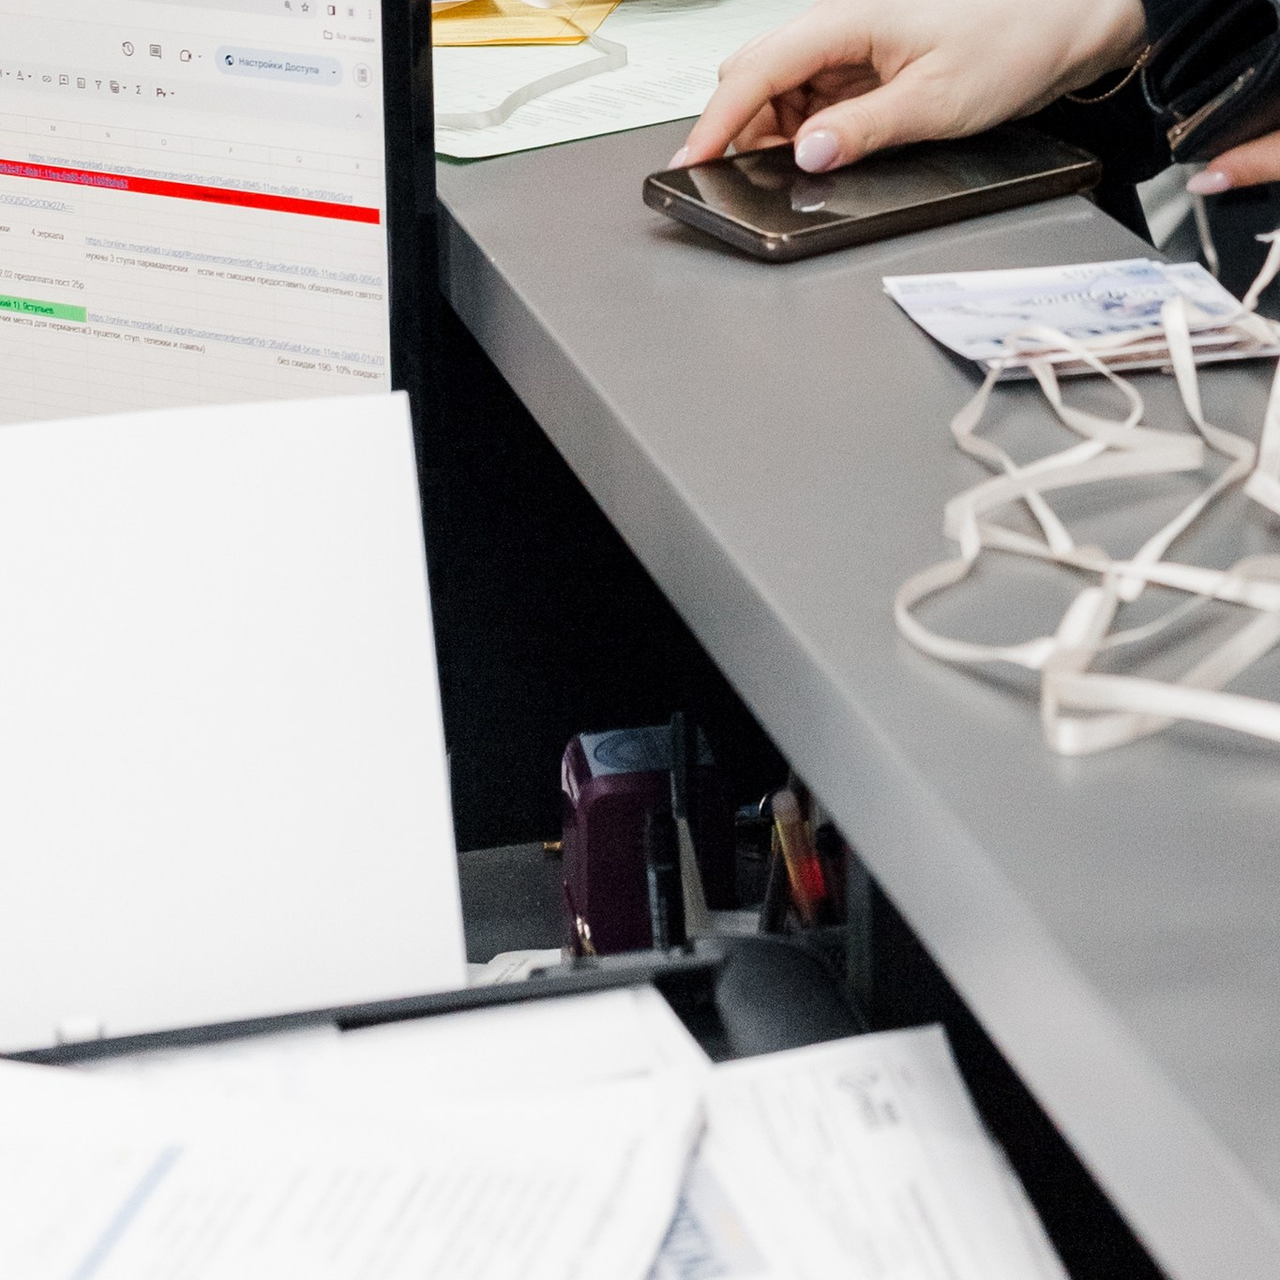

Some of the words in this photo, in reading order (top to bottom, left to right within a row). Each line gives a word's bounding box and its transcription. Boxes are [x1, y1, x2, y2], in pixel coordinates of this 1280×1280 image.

[238, 56, 283, 70] Настройки
[284, 61, 319, 75] Доступа
[31, 227, 36, 236] 4
[37, 228, 64, 240] зеркала
[109, 251, 114, 262] 3
[115, 254, 135, 266] стула
[14, 271, 53, 285] предоплата
[54, 277, 70, 287] пост
[197, 267, 214, 277] если
[215, 269, 225, 278] не
[257, 275, 306, 291] предоставить
[307, 281, 354, 297] обязательно
[13, 316, 33, 326] места
[34, 320, 47, 329] для
[143, 336, 170, 348] тележки
[179, 341, 206, 354] лампы)
[277, 355, 290, 366] без
[291, 358, 316, 371] скидки
[335, 364, 351, 375] 10%
